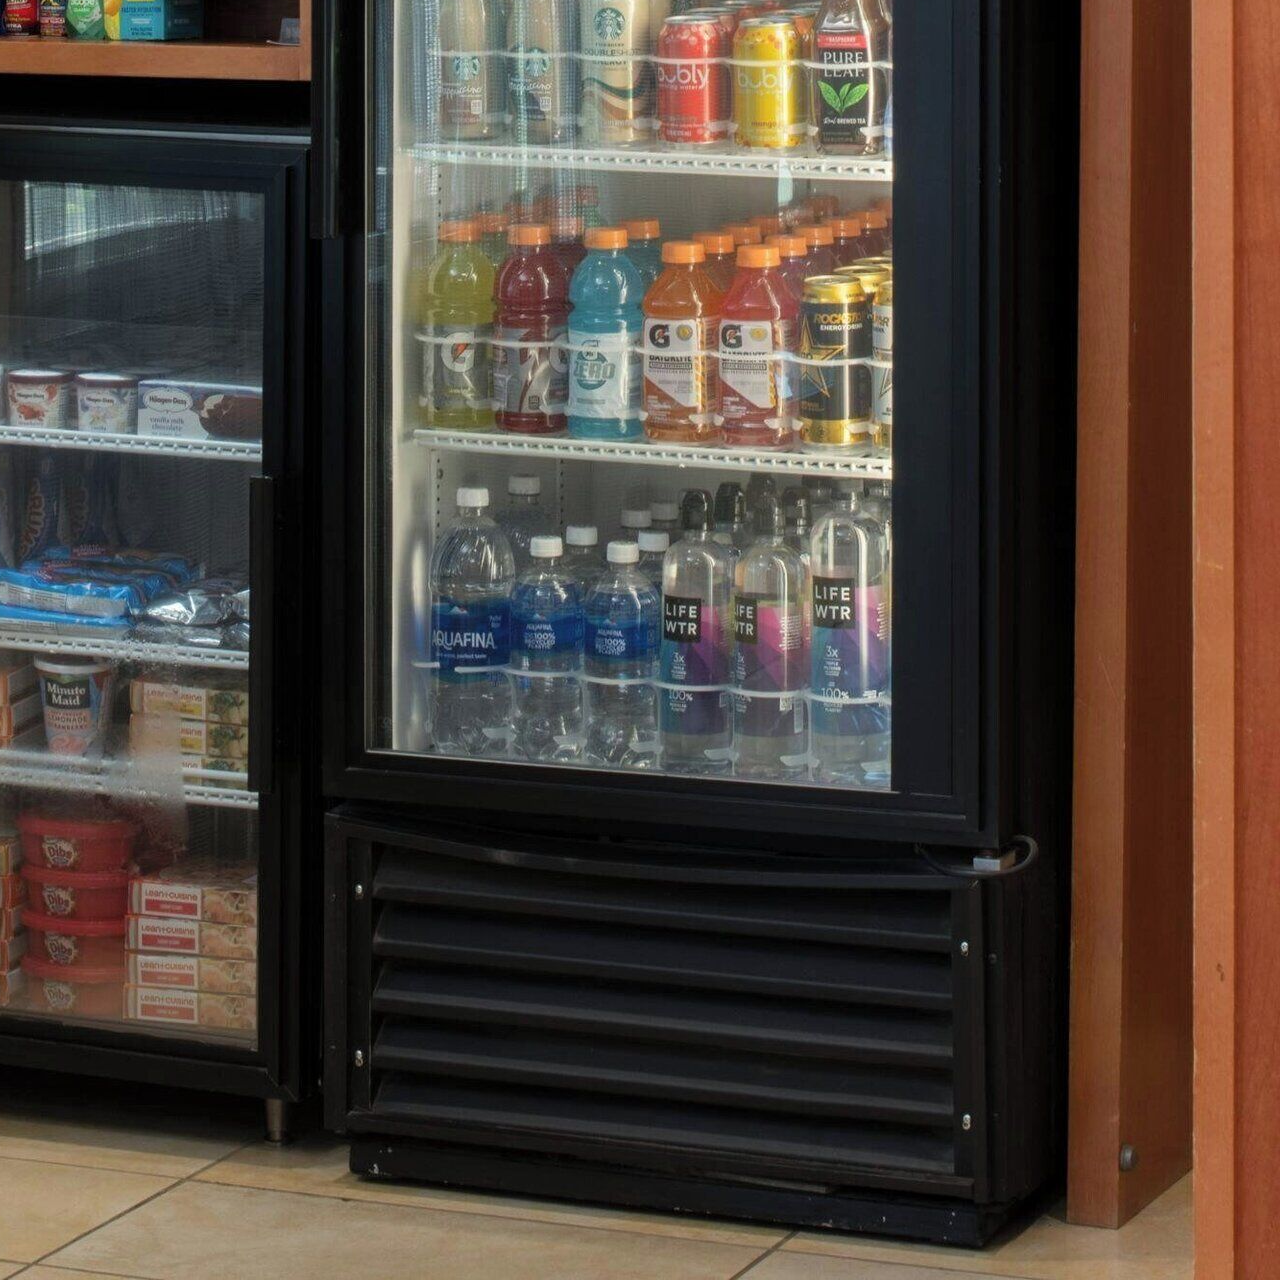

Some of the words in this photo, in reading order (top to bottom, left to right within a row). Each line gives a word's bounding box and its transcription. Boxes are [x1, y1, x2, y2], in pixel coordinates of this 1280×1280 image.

[823, 52, 865, 65] PURE
[815, 584, 850, 601] LIFE
[665, 605, 697, 618] LIFE
[815, 604, 851, 620] WTR
[665, 622, 697, 635] WTR
[432, 630, 496, 650] AQUAFINA
[534, 632, 556, 640] 100%
[604, 638, 626, 646] 100%
[674, 653, 685, 663] 3x
[826, 646, 838, 657] 3x
[47, 682, 86, 695] Minute
[52, 694, 80, 706] Maid
